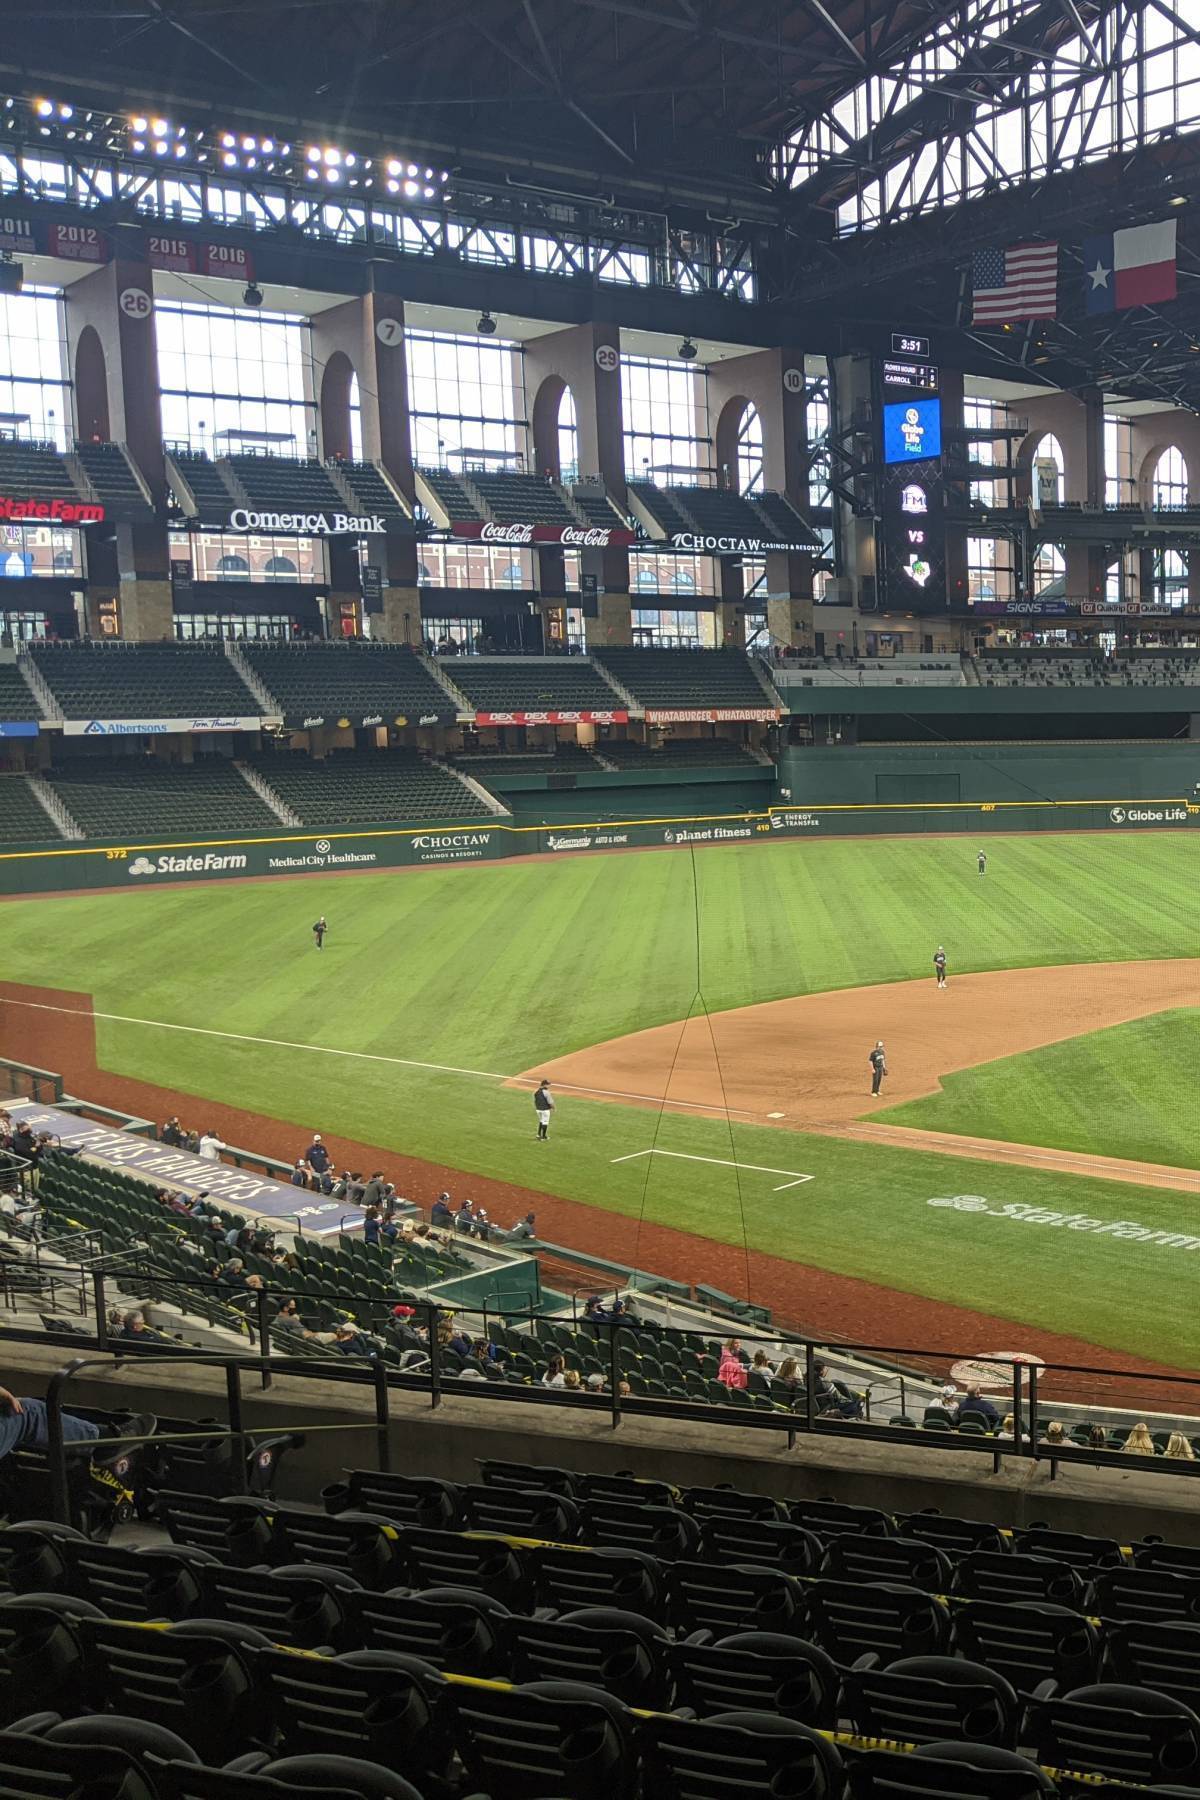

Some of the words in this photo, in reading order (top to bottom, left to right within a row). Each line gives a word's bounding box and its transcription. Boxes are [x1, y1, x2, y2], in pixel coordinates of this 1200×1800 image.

[57, 225, 98, 244] 2012
[150, 237, 187, 256] 2015
[208, 244, 245, 264] 2016
[124, 294, 149, 312] 26
[384, 324, 396, 341] 7
[901, 340, 921, 352] 3:51
[598, 350, 617, 367] 29
[788, 372, 800, 388] 10
[885, 374, 911, 384] CARROLL
[902, 423, 924, 435] Globe
[905, 432, 920, 444] Life
[904, 443, 922, 453] Field
[333, 514, 387, 533] Bank
[908, 530, 924, 543] VS
[761, 542, 789, 550] CASINOS
[796, 544, 823, 552] RESORTS
[490, 712, 514, 720] DEX
[524, 712, 548, 720] DEX
[558, 712, 582, 720] DEX
[649, 710, 712, 722] WHATABURGER
[716, 710, 776, 720] WHATABURGER
[108, 724, 168, 733] Albertsons
[188, 720, 208, 728] Tom
[210, 718, 240, 728] Thumb
[1128, 810, 1163, 822] Globe
[1166, 808, 1186, 820] Life
[756, 824, 770, 832] 410
[420, 834, 490, 848] CHOCTAW
[613, 834, 628, 843] HOME
[676, 829, 712, 843] planet
[714, 827, 752, 838] fitness
[106, 850, 128, 860] 372
[269, 856, 306, 868] Medical
[306, 856, 326, 866] City
[328, 852, 376, 864] Healthcare
[61, 1128, 162, 1162] TEXAS
[134, 1152, 281, 1200] RANGERS
